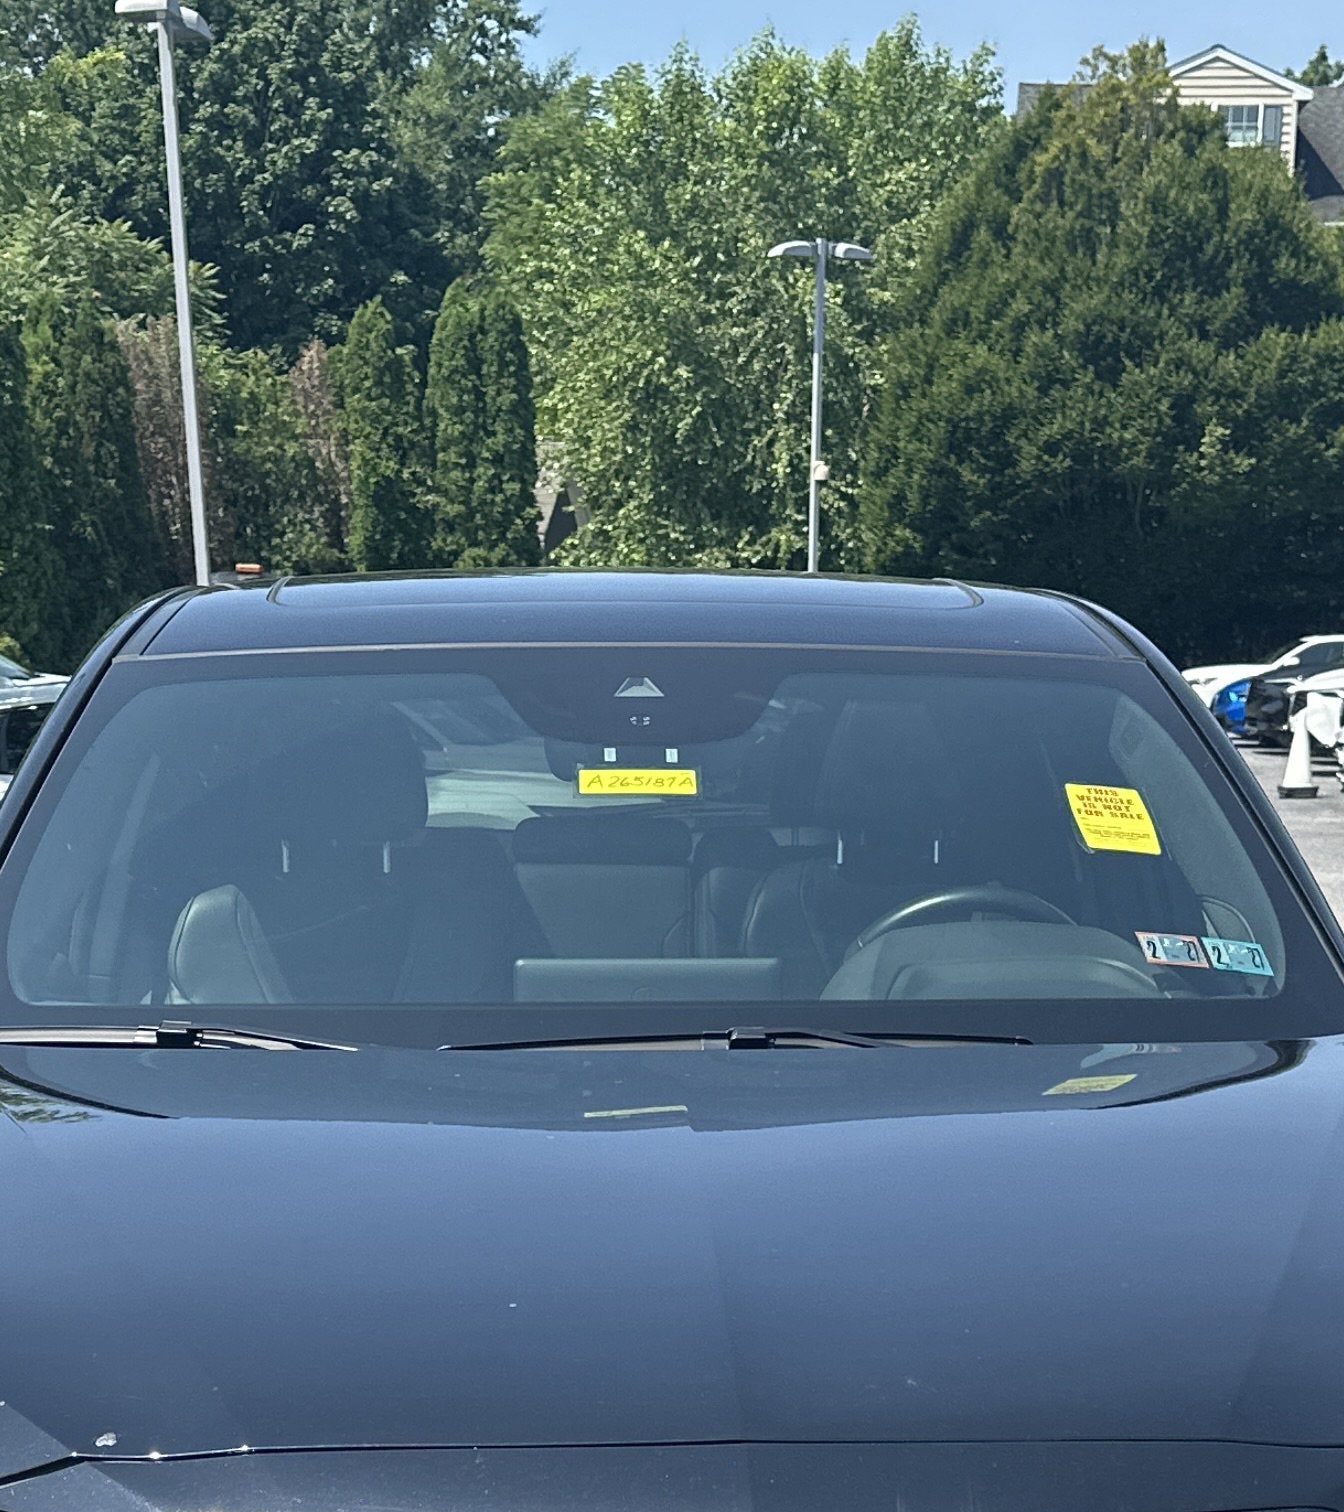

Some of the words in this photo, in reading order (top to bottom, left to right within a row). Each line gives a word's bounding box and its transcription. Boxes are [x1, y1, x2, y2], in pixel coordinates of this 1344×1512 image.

[1076, 794, 1134, 805] VEHICLE
[1102, 803, 1131, 812] NOT
[1077, 808, 1104, 817] FOR
[1109, 811, 1144, 820] SALE
